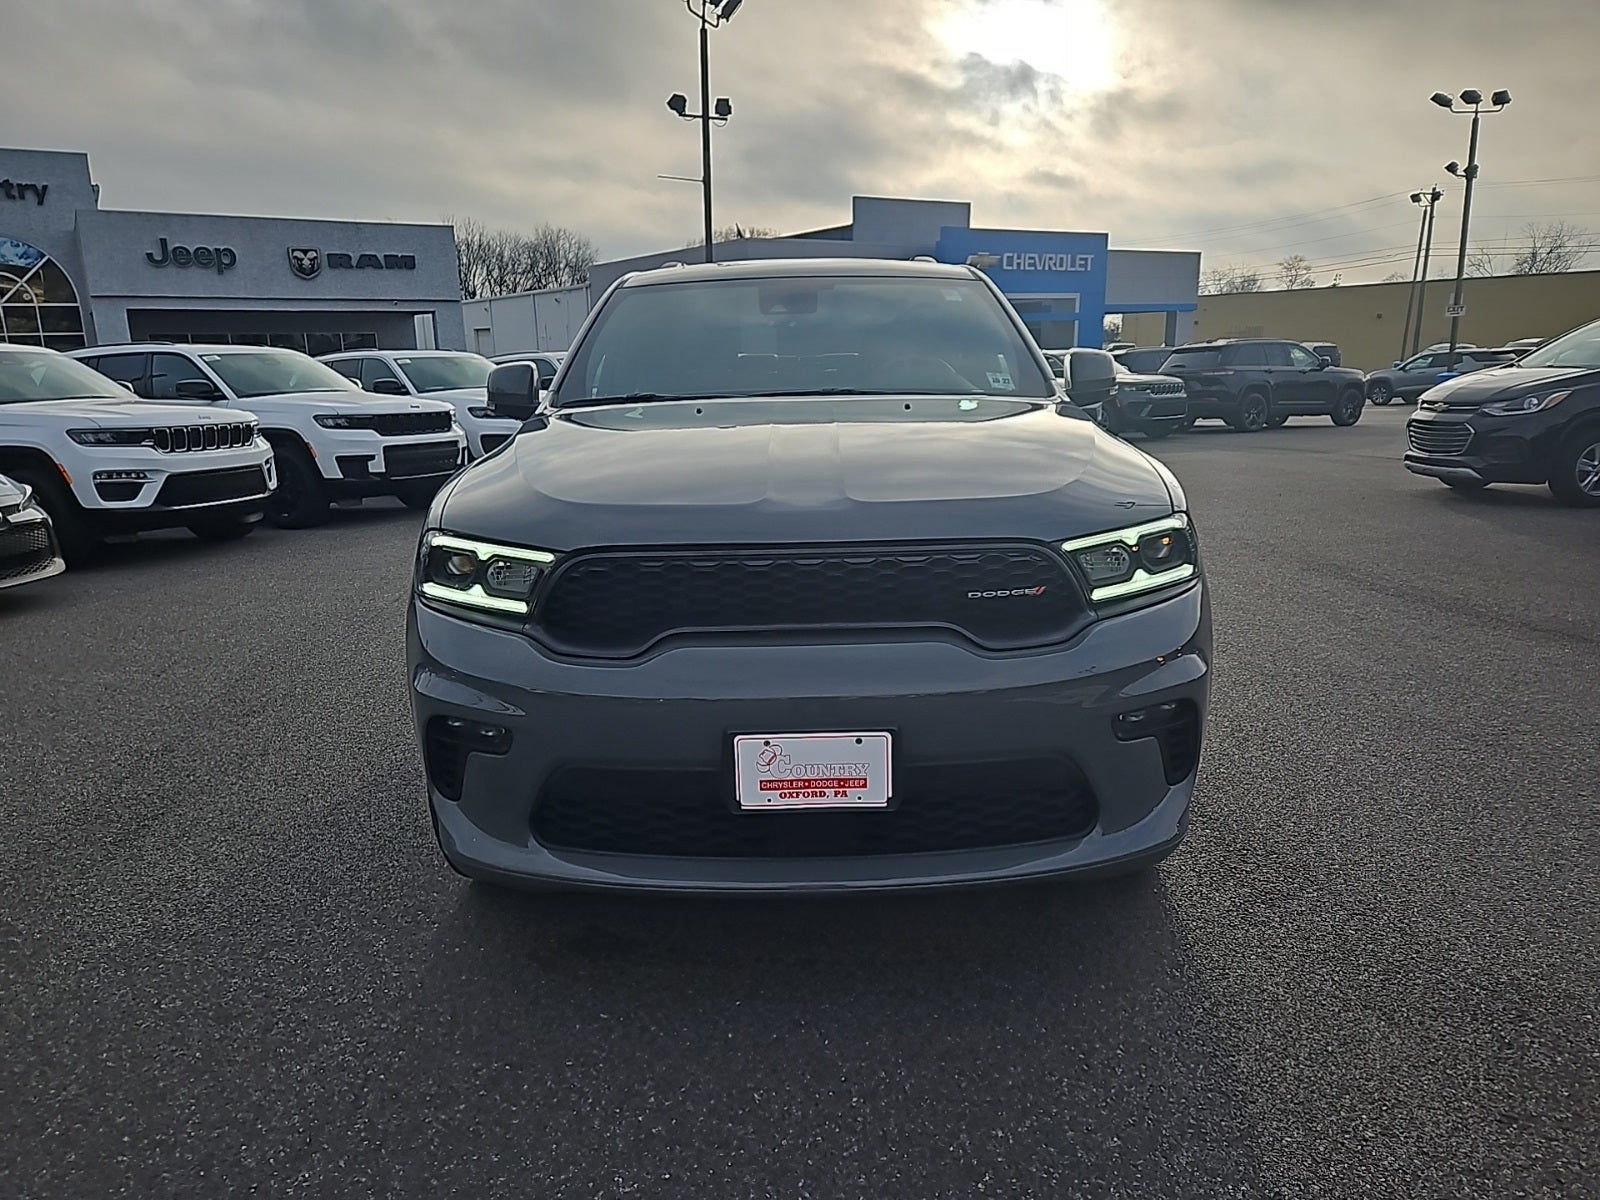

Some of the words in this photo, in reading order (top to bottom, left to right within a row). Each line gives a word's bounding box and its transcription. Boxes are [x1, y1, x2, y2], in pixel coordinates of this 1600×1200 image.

[145, 237, 237, 275] Jeep
[326, 252, 416, 270] RAM
[1002, 253, 1094, 271] CHEVROLET
[967, 587, 1035, 599] DODGE
[769, 754, 870, 779] COUNTRY
[761, 781, 804, 789] CHRYSLER
[810, 780, 839, 788] DODGE
[845, 779, 865, 787] JEEP
[779, 790, 830, 800] OXFORD,
[834, 790, 848, 798] PA
